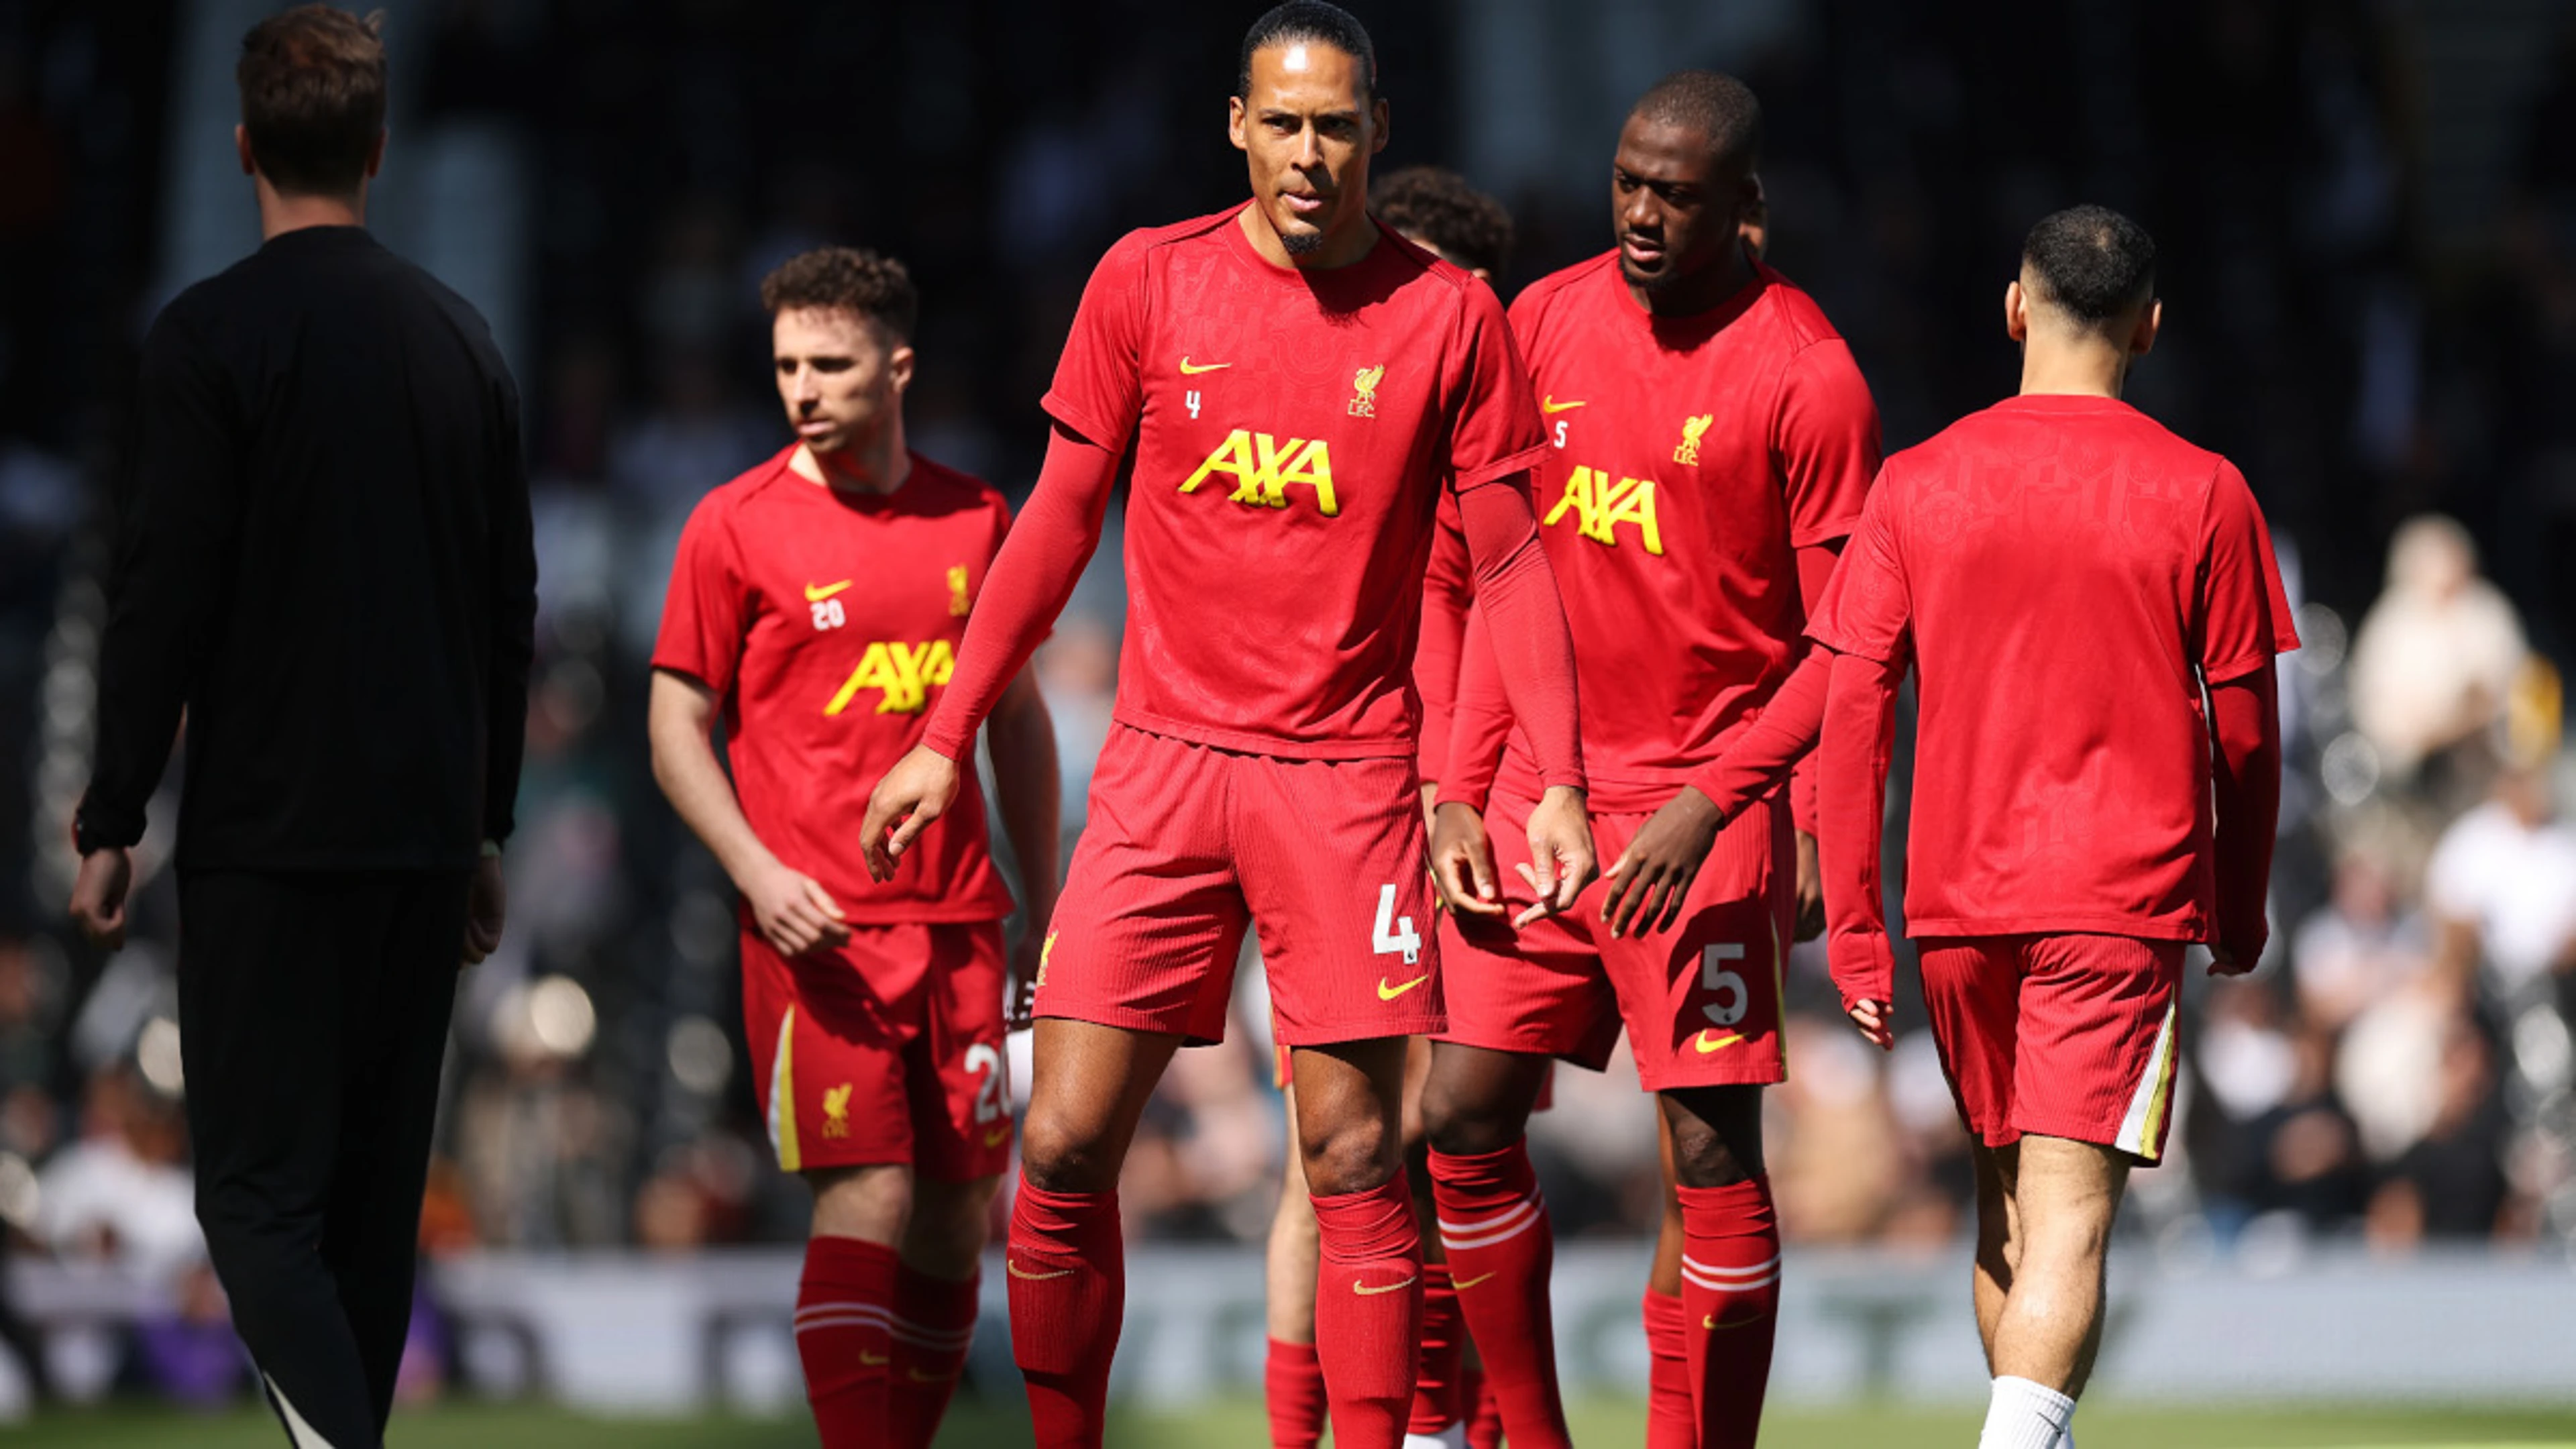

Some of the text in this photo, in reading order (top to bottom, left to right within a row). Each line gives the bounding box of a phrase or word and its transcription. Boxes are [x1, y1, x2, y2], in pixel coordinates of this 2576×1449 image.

[1185, 390, 1201, 419] 4
[1554, 420, 1568, 449] 5
[1179, 429, 1336, 512] AXA
[1544, 466, 1662, 553] AXA
[810, 598, 846, 631] 20
[1373, 883, 1421, 965] 4
[1702, 943, 1748, 1025] 5
